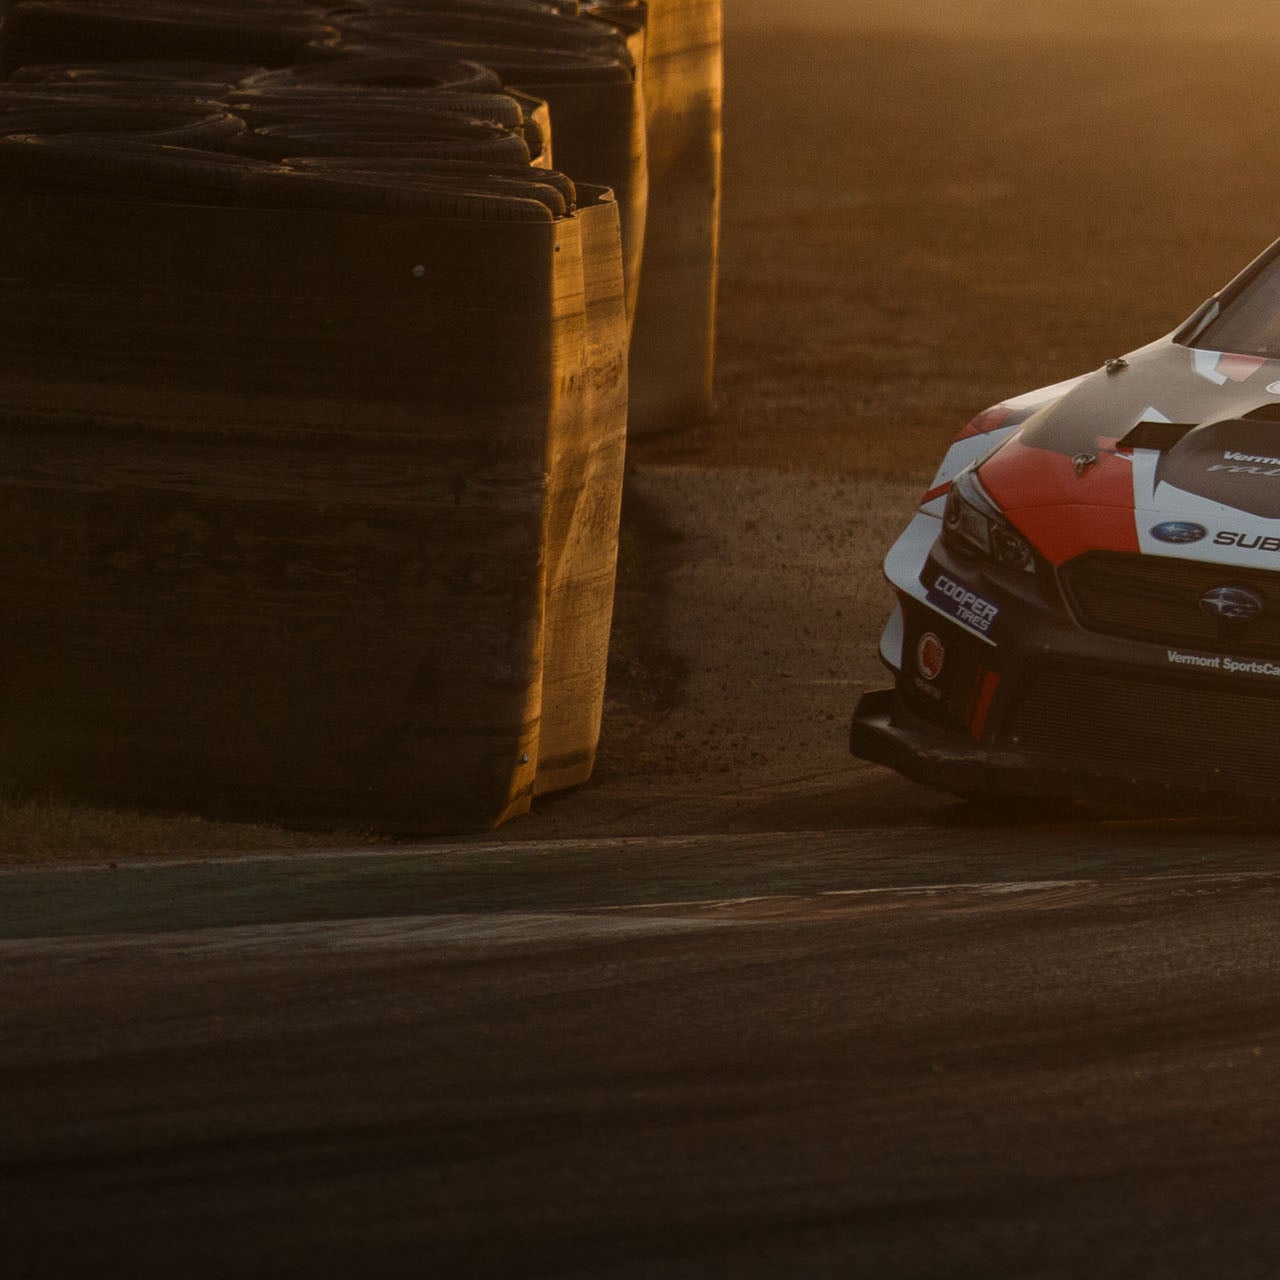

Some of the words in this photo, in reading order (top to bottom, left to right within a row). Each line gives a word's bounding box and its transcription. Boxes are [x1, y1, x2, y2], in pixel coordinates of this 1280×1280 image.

[934, 575, 999, 622] COOPER
[956, 605, 992, 632] TIRES
[1167, 650, 1220, 669] Vermont
